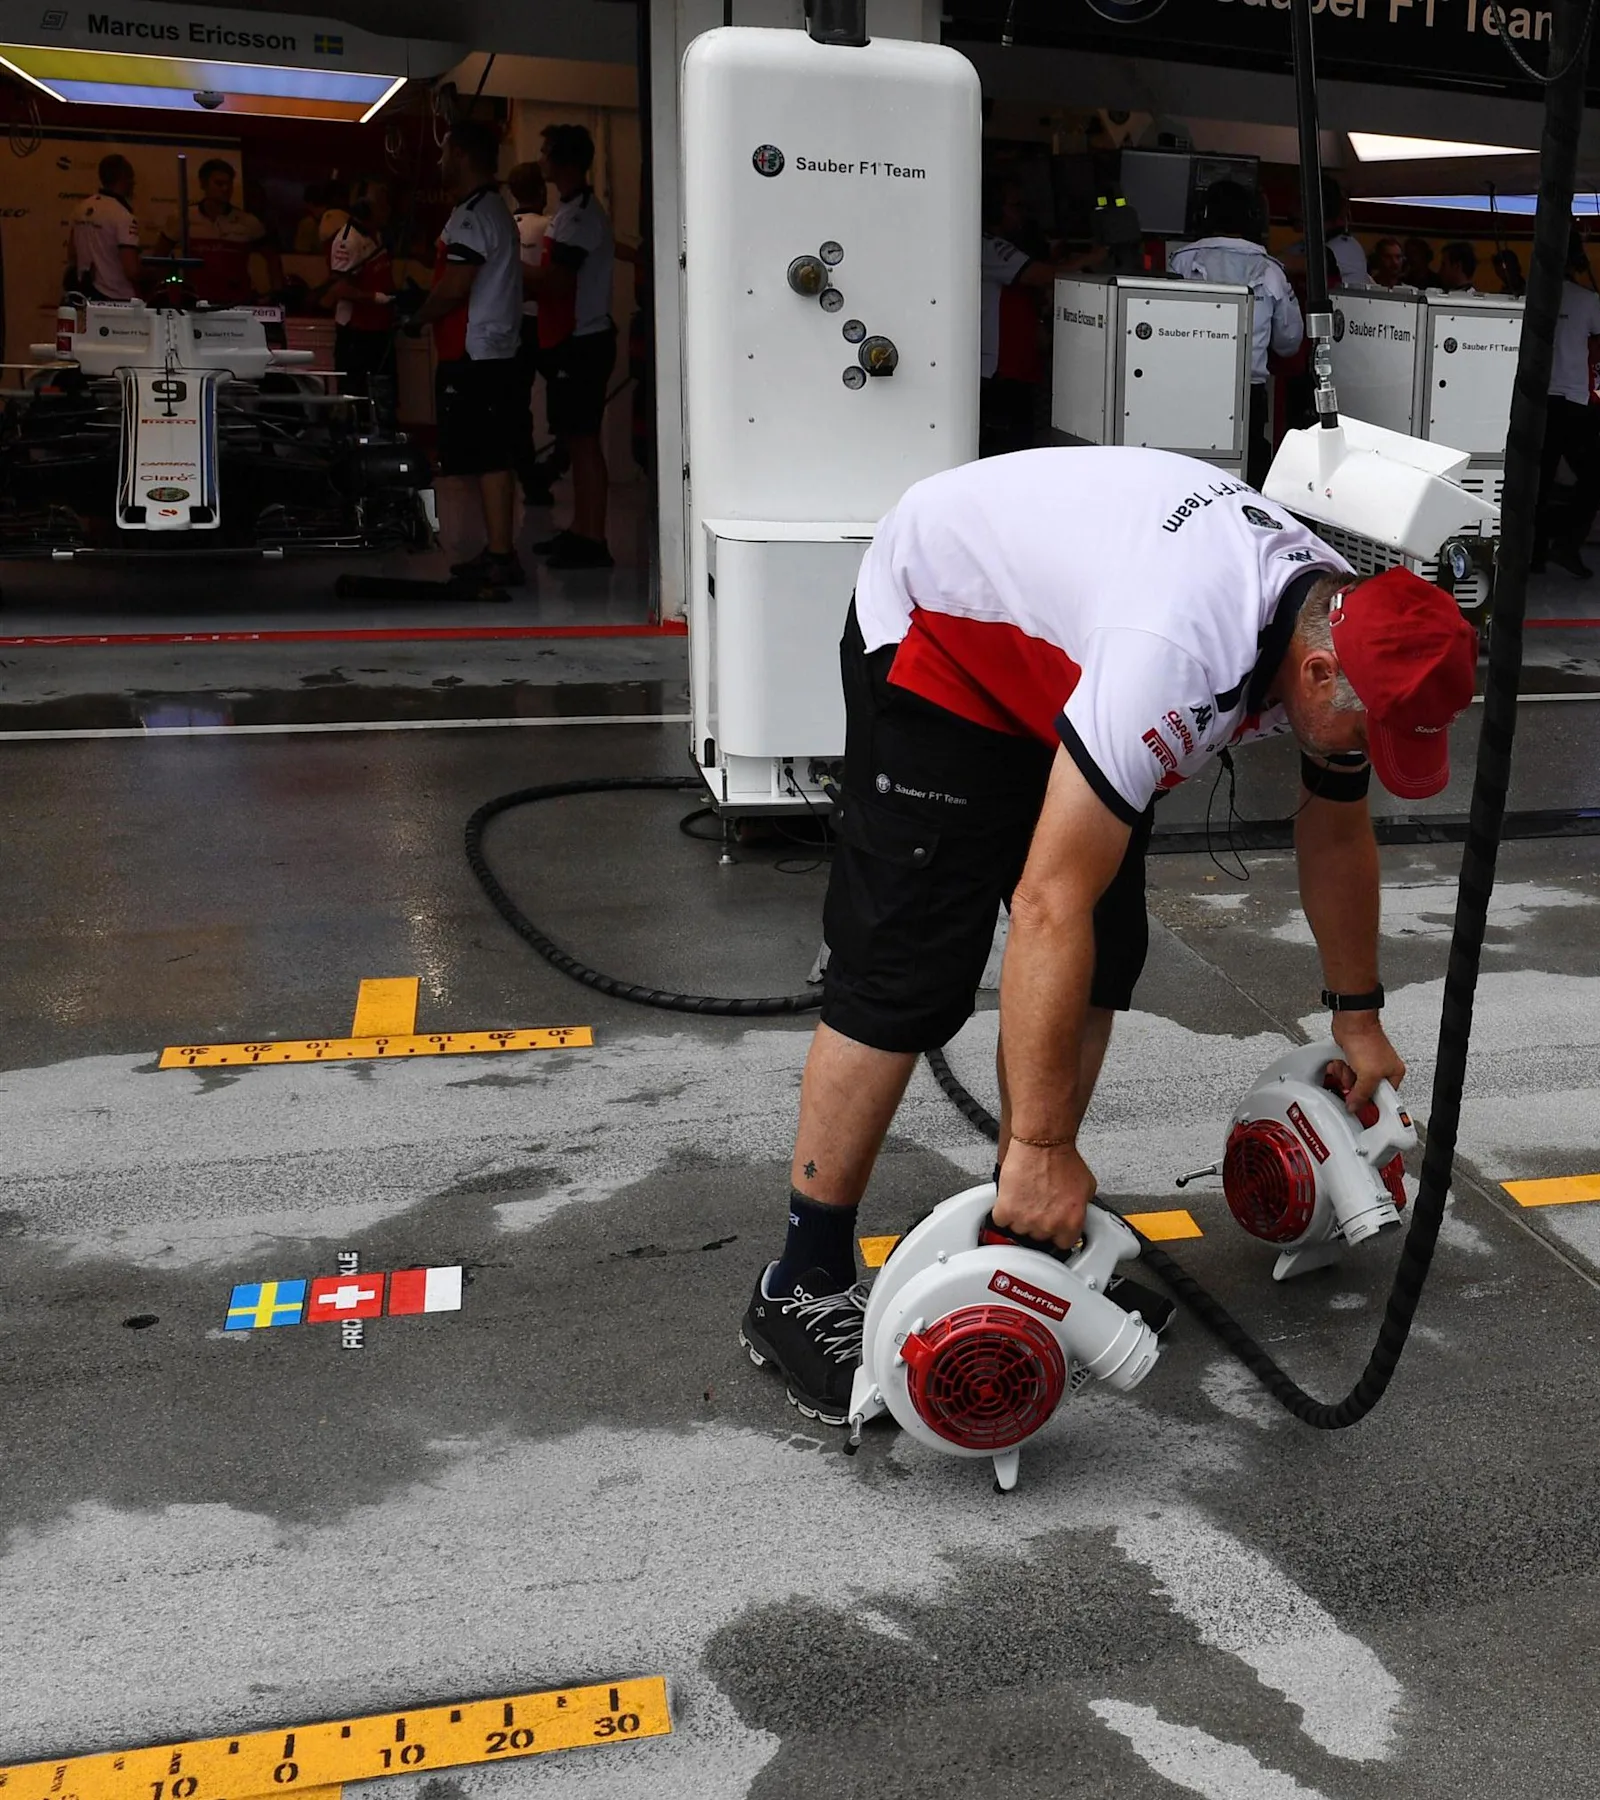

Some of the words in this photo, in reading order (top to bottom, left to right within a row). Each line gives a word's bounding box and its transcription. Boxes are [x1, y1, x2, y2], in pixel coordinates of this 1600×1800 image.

[88, 14, 180, 40] Marcus
[189, 24, 296, 50] Ericsson
[796, 157, 854, 174] Sauber
[884, 163, 926, 179] Team
[1158, 327, 1190, 338] Sauber
[1206, 330, 1230, 340] Team
[1349, 320, 1376, 338] Sauber
[1390, 325, 1411, 342] Team
[1462, 342, 1488, 351] Sauber
[1501, 344, 1519, 352] Team
[151, 380, 187, 402] 9
[1161, 492, 1213, 533] Team
[894, 783, 927, 799] Sauber
[944, 793, 968, 805] Team
[1011, 1285, 1036, 1302] Sauber
[1047, 1300, 1065, 1315] Team
[149, 1776, 199, 1800] 10
[273, 1761, 299, 1784] 0
[379, 1744, 427, 1768] 10
[485, 1728, 535, 1754] 20
[592, 1712, 642, 1736] 30
